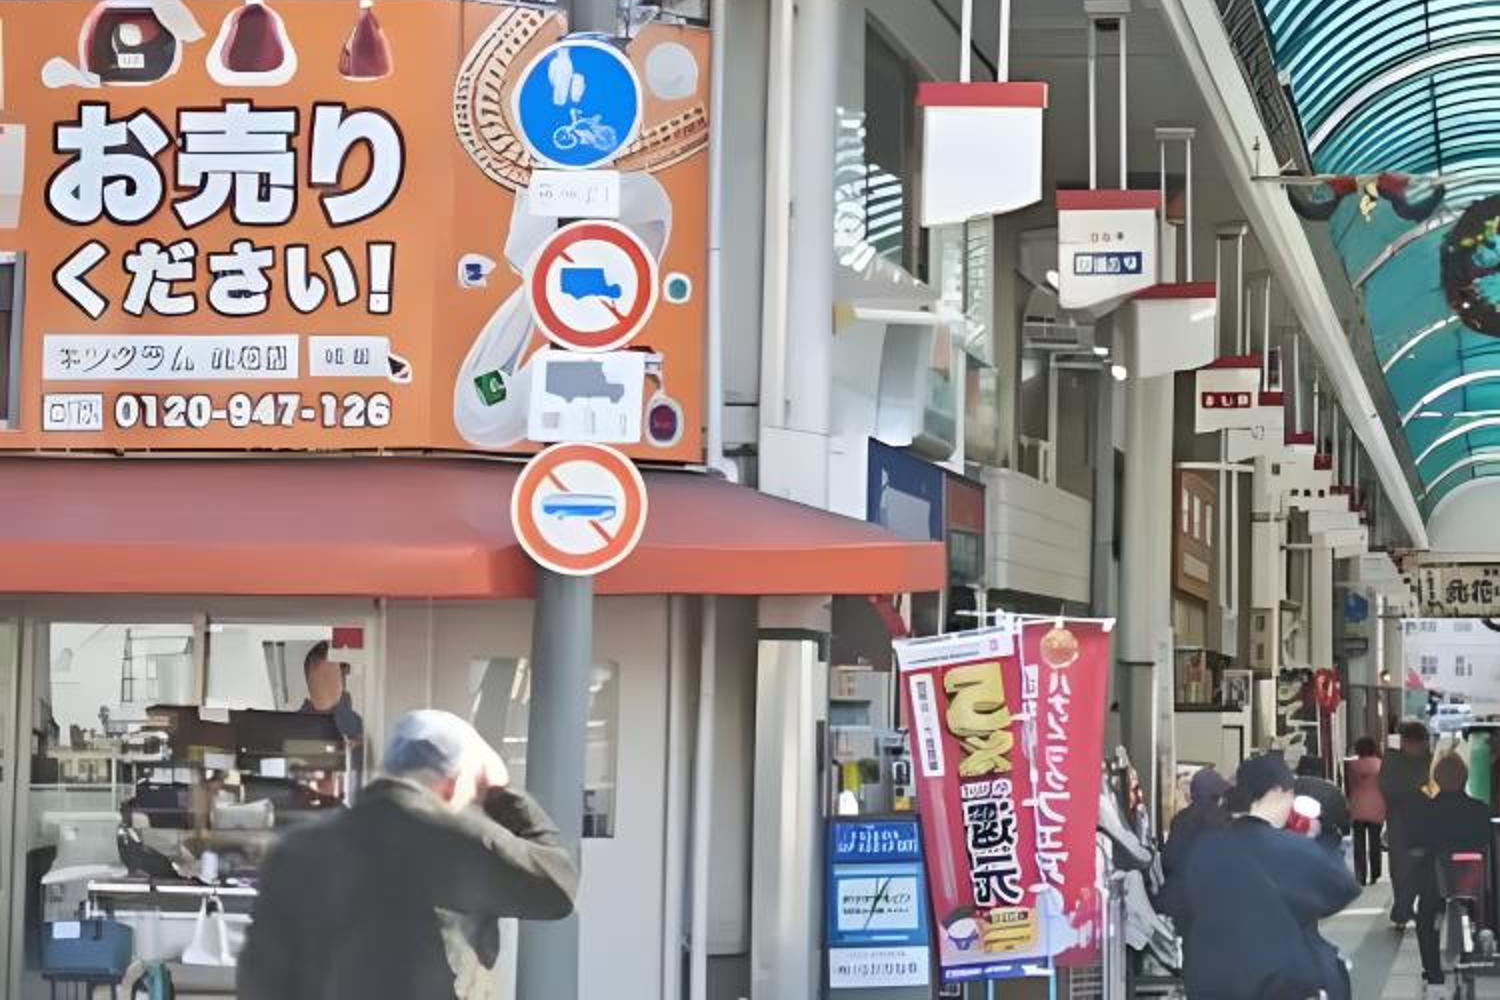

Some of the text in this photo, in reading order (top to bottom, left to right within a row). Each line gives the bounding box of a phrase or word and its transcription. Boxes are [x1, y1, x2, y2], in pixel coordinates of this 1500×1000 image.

[50, 101, 404, 225] お売り
[113, 392, 391, 429] 0120-947-126
